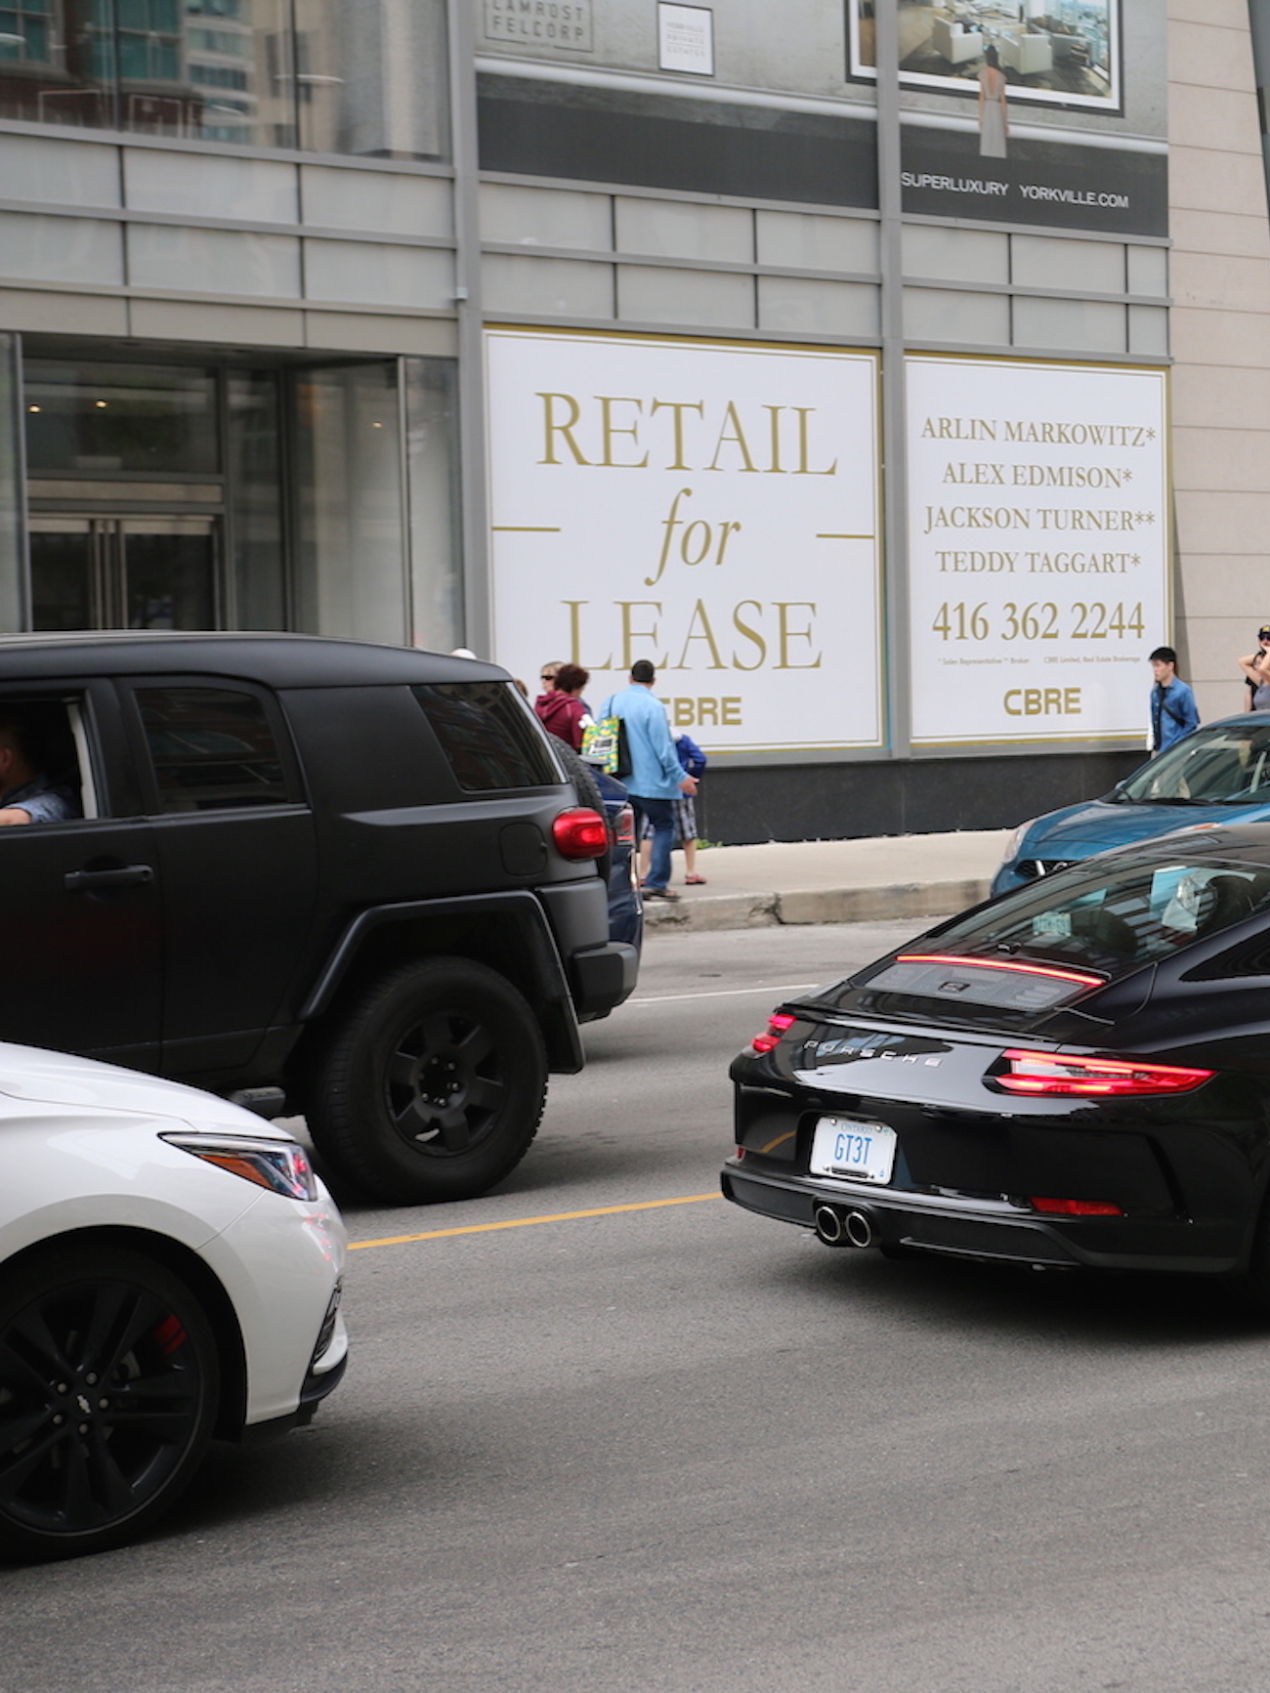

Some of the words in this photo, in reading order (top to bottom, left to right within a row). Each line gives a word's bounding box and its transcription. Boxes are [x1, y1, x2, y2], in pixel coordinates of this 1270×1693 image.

[492, 15, 584, 42] FELCORP
[901, 171, 1009, 196] SUPERLUXURY
[1019, 185, 1129, 208] YORKVILLE.COM
[534, 392, 838, 475] RETAIL
[921, 416, 997, 441] ARLIN
[942, 462, 1005, 485] ALEX
[924, 506, 1030, 534] JACKSON
[644, 487, 742, 586] for
[935, 551, 1019, 573] TEDDY
[561, 598, 822, 671] LEASE
[932, 602, 989, 640] 416
[1001, 602, 1059, 640] 362
[1070, 602, 1145, 640] 2244
[1003, 687, 1082, 716] CBRE
[803, 1040, 943, 1067] PORSCHE
[834, 1133, 873, 1165] GT3T
